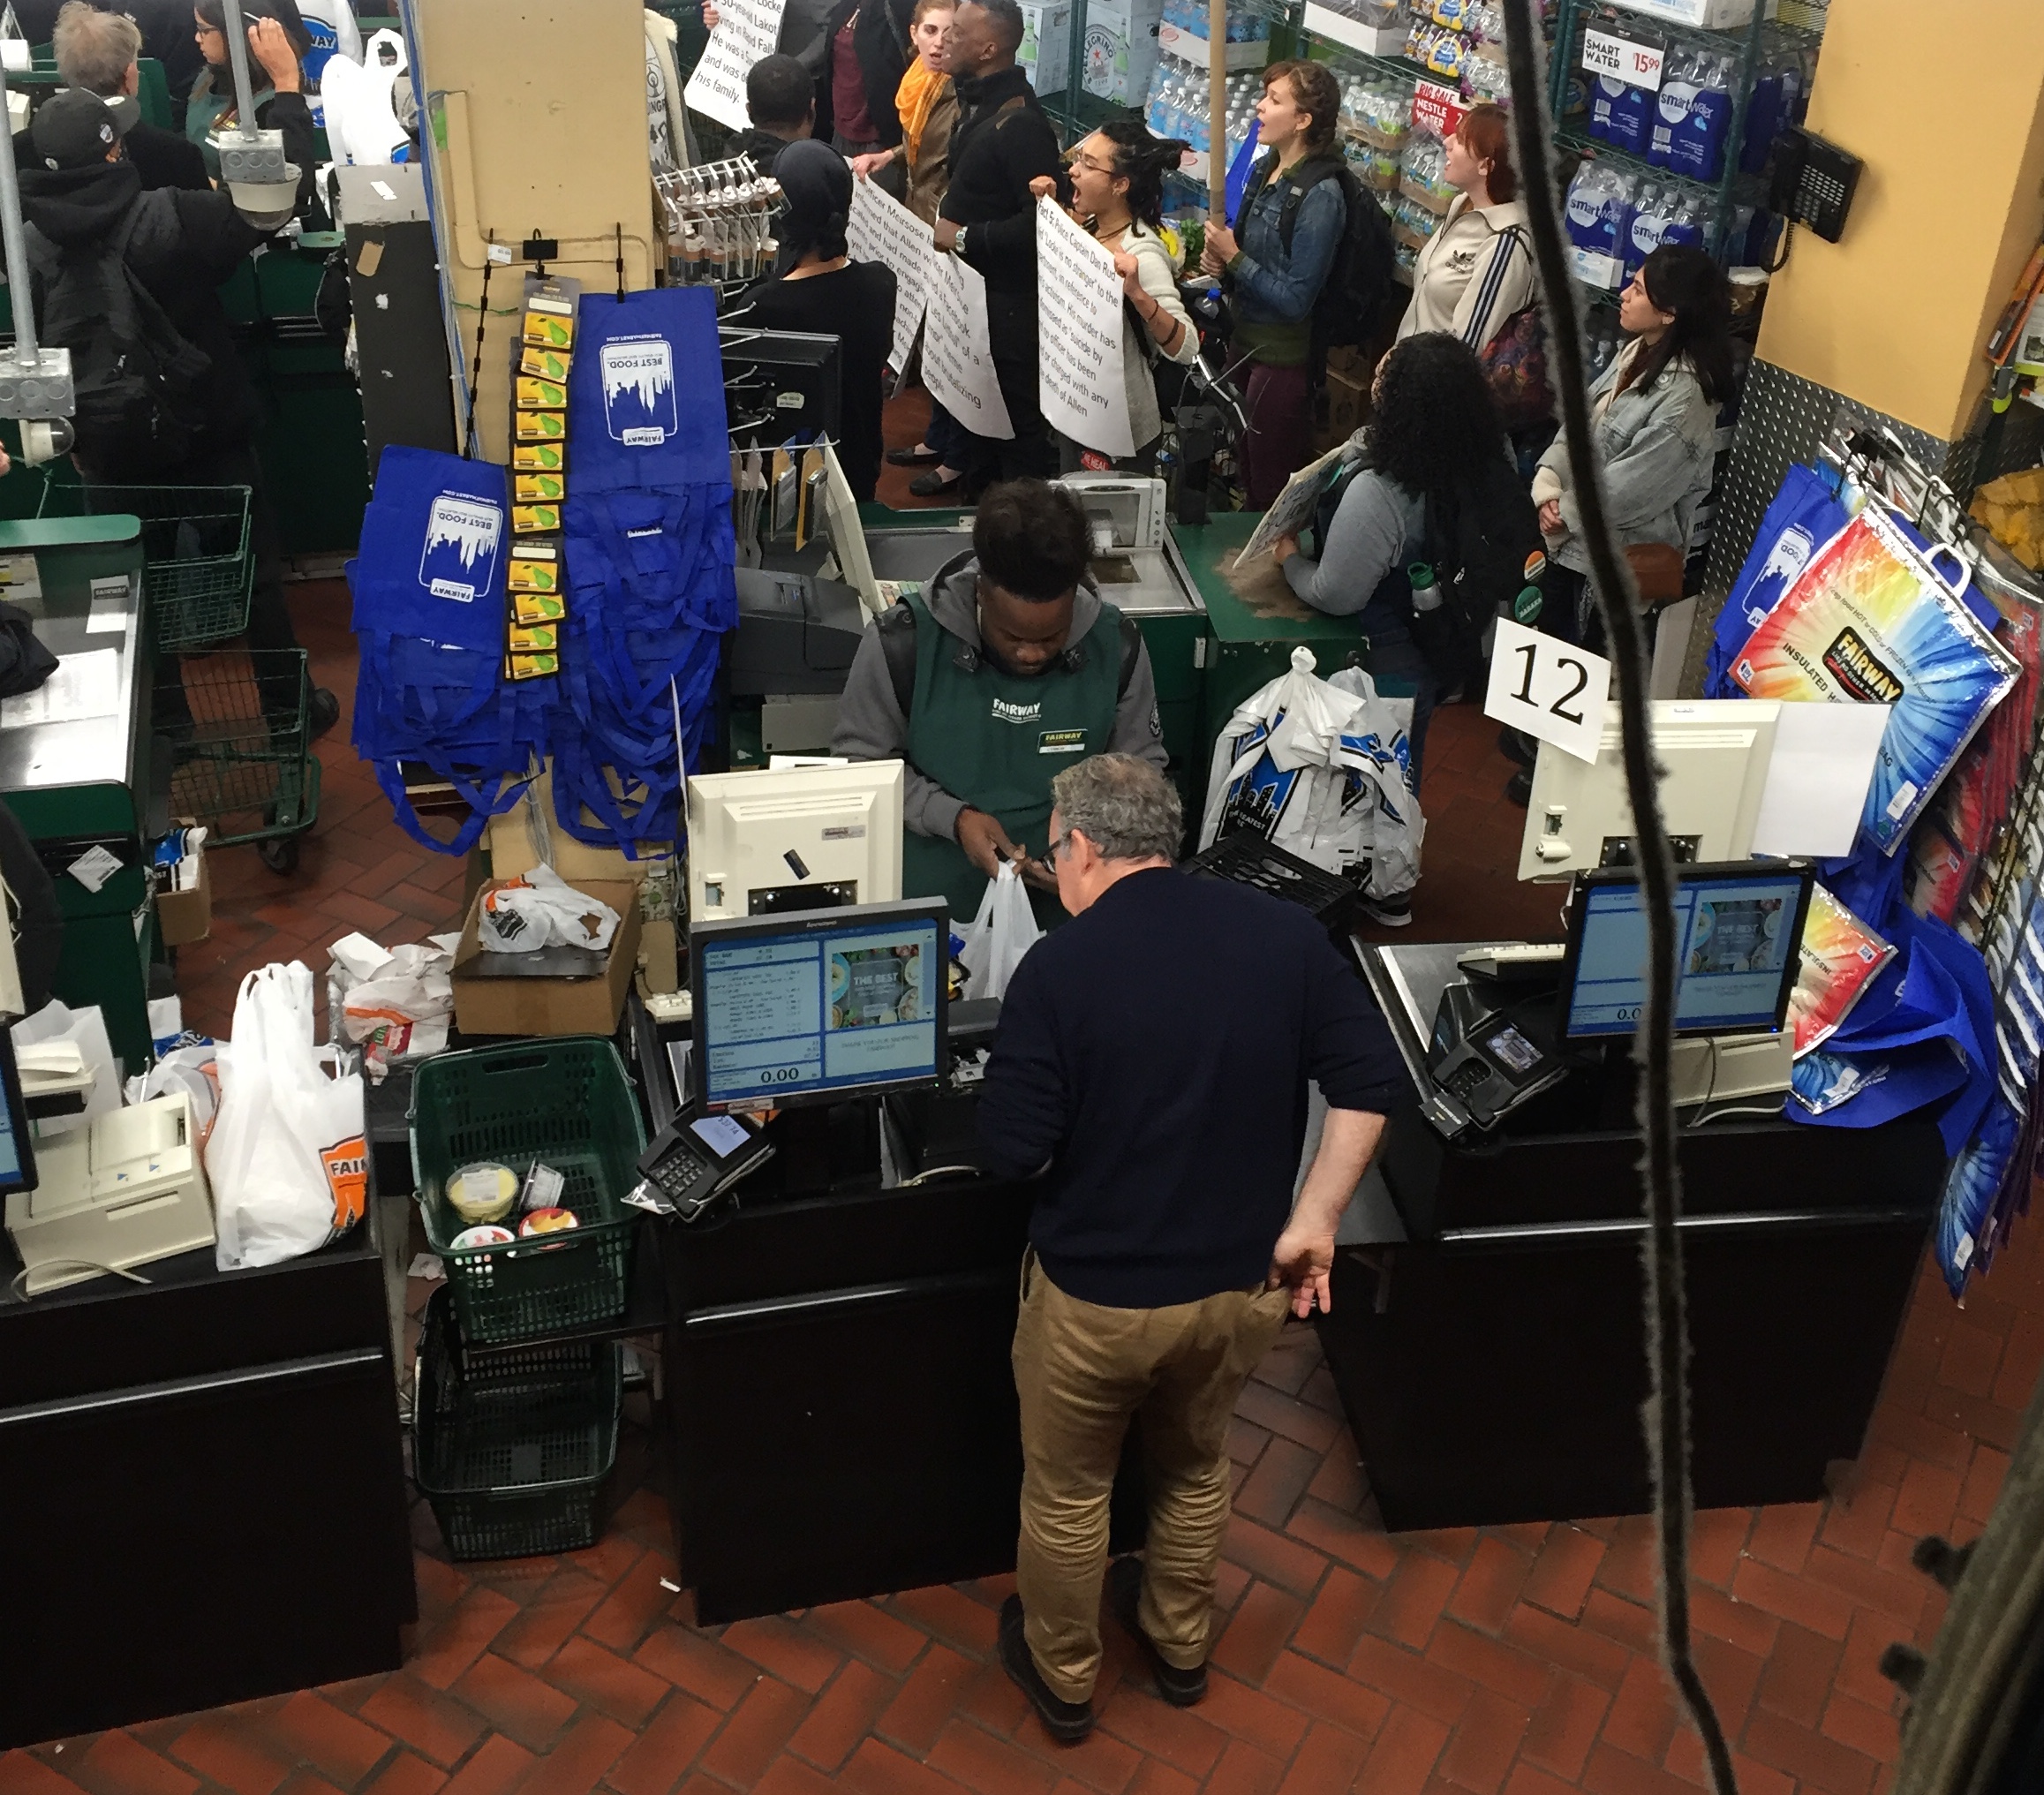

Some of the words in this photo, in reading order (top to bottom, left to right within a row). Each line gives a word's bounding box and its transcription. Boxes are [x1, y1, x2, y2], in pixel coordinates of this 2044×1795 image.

[758, 0, 781, 14] Locke
[712, 31, 723, 47] He
[726, 41, 739, 57] was
[1586, 38, 1620, 58] SMART
[705, 54, 722, 69] and
[723, 64, 739, 79] was
[1585, 49, 1620, 70] WATER
[695, 71, 711, 87] his
[713, 79, 739, 104] family.
[1419, 83, 1433, 99] BIG
[1434, 87, 1455, 106] SALE
[1415, 109, 1444, 129] WATER
[1416, 98, 1448, 118] NESTLE
[865, 186, 886, 209] fficer
[884, 221, 898, 238] that
[901, 234, 921, 256] Allen
[869, 226, 882, 242] and
[883, 238, 898, 255] had
[899, 253, 921, 275] made
[1069, 232, 1090, 260] Captain
[1090, 251, 1101, 270] Dan
[886, 258, 894, 270] to
[1065, 255, 1072, 268] no
[1097, 283, 1104, 298] to
[1105, 290, 1119, 307] the
[1076, 314, 1098, 339] murder
[1100, 331, 1116, 350] has
[607, 359, 639, 369] FOOD.
[641, 358, 663, 367] BEST
[973, 355, 980, 366] a
[1093, 348, 1103, 366] by
[1077, 358, 1096, 381] been
[1060, 390, 1067, 403] of
[1067, 395, 1088, 418] Allen
[1072, 379, 1089, 397] with
[1091, 391, 1109, 410] any
[626, 435, 662, 444] FAIRWAY
[437, 511, 467, 524] FOOD.
[469, 520, 493, 530] BEST
[433, 586, 471, 600] FAIRWAY
[1852, 608, 1867, 622] HOT
[1885, 646, 1908, 670] FROZEN
[1783, 642, 1829, 692] INSULATED
[1837, 633, 1900, 702] FAIRWAY
[1510, 644, 1588, 726] 12
[993, 698, 1041, 716] FAIRWAY
[1045, 732, 1082, 741] FAIRWAY
[760, 1067, 799, 1083] 0.00
